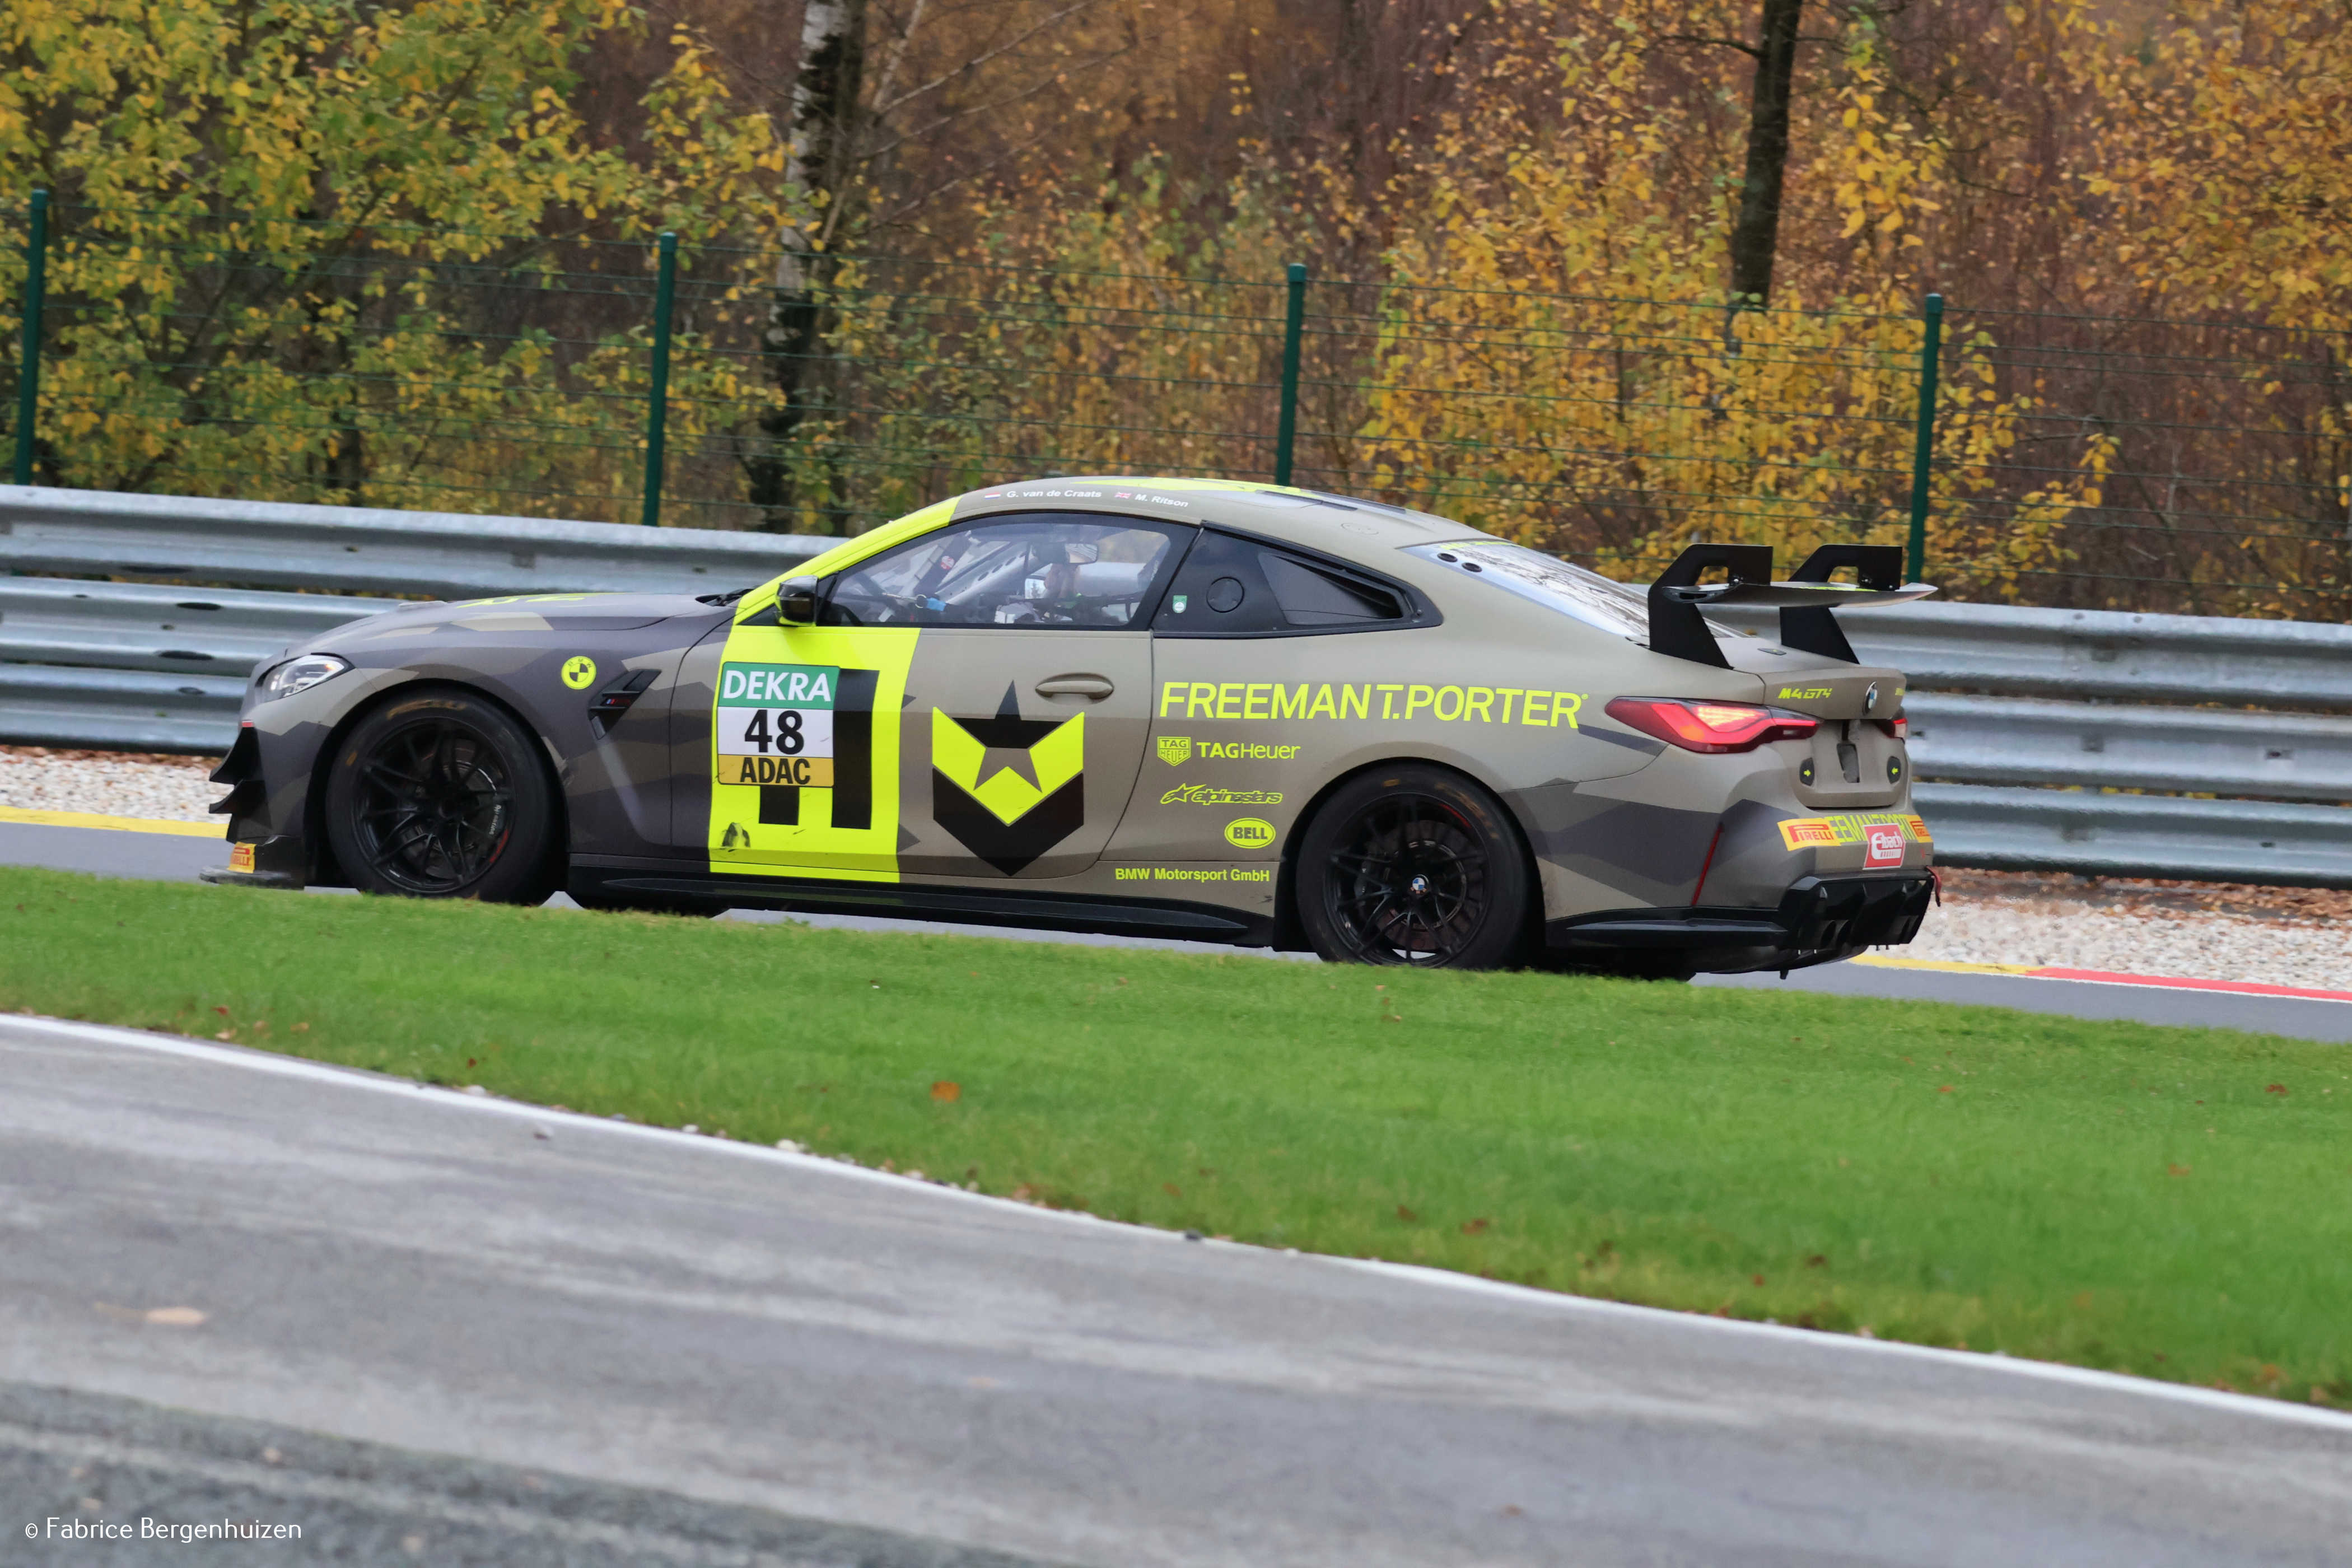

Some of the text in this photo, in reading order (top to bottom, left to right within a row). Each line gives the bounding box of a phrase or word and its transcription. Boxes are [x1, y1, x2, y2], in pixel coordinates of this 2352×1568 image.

[1064, 489, 1102, 498] Craats
[1135, 493, 1189, 507] M. Ritson
[722, 670, 832, 702] DEKRA
[744, 709, 804, 755] 48
[1161, 739, 1187, 748] TAG
[739, 757, 811, 785] ADAC
[1233, 827, 1268, 839] BELL
[1788, 824, 1834, 843] PIRELLI
[1115, 868, 1270, 883] BMW Motorsport GmbH
